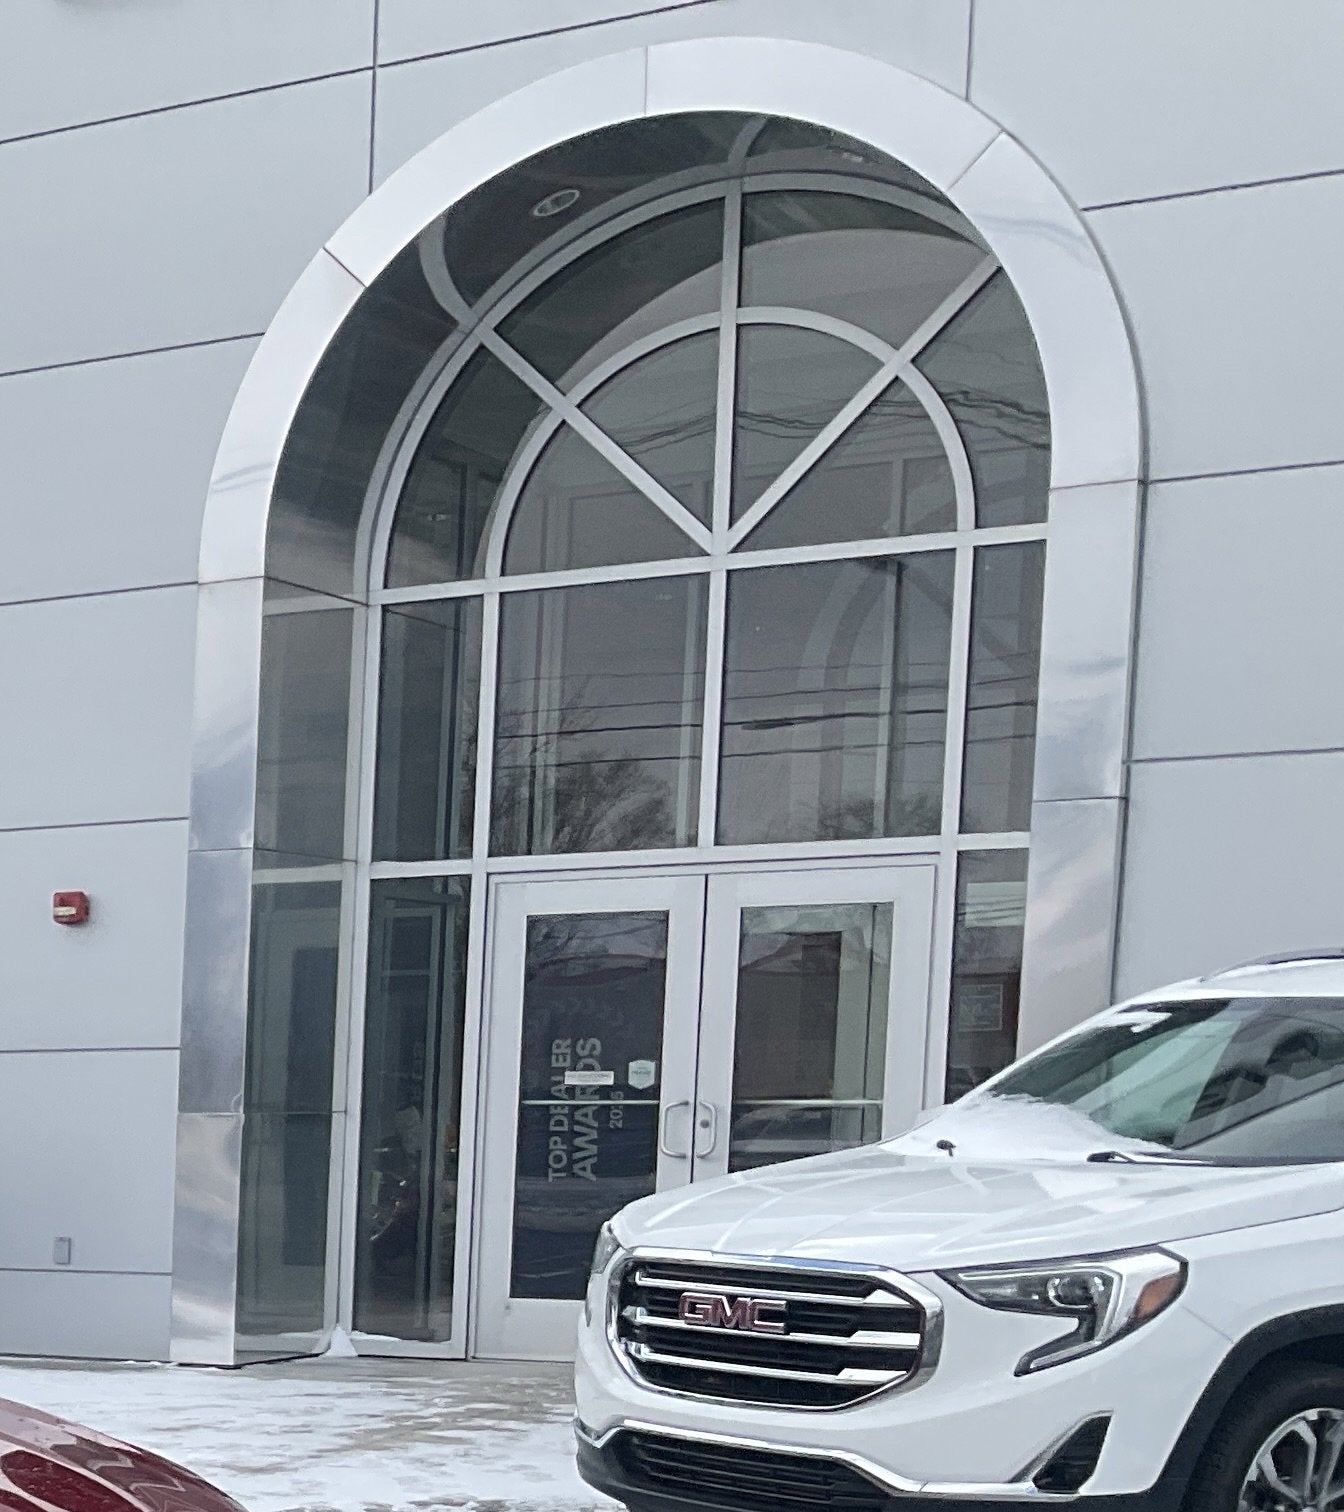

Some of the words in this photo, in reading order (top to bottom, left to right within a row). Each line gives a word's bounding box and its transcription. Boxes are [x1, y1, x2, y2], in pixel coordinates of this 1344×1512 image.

[572, 1037, 602, 1182] AWARDS
[547, 1135, 568, 1183] TOP
[678, 1291, 787, 1335] GMC
